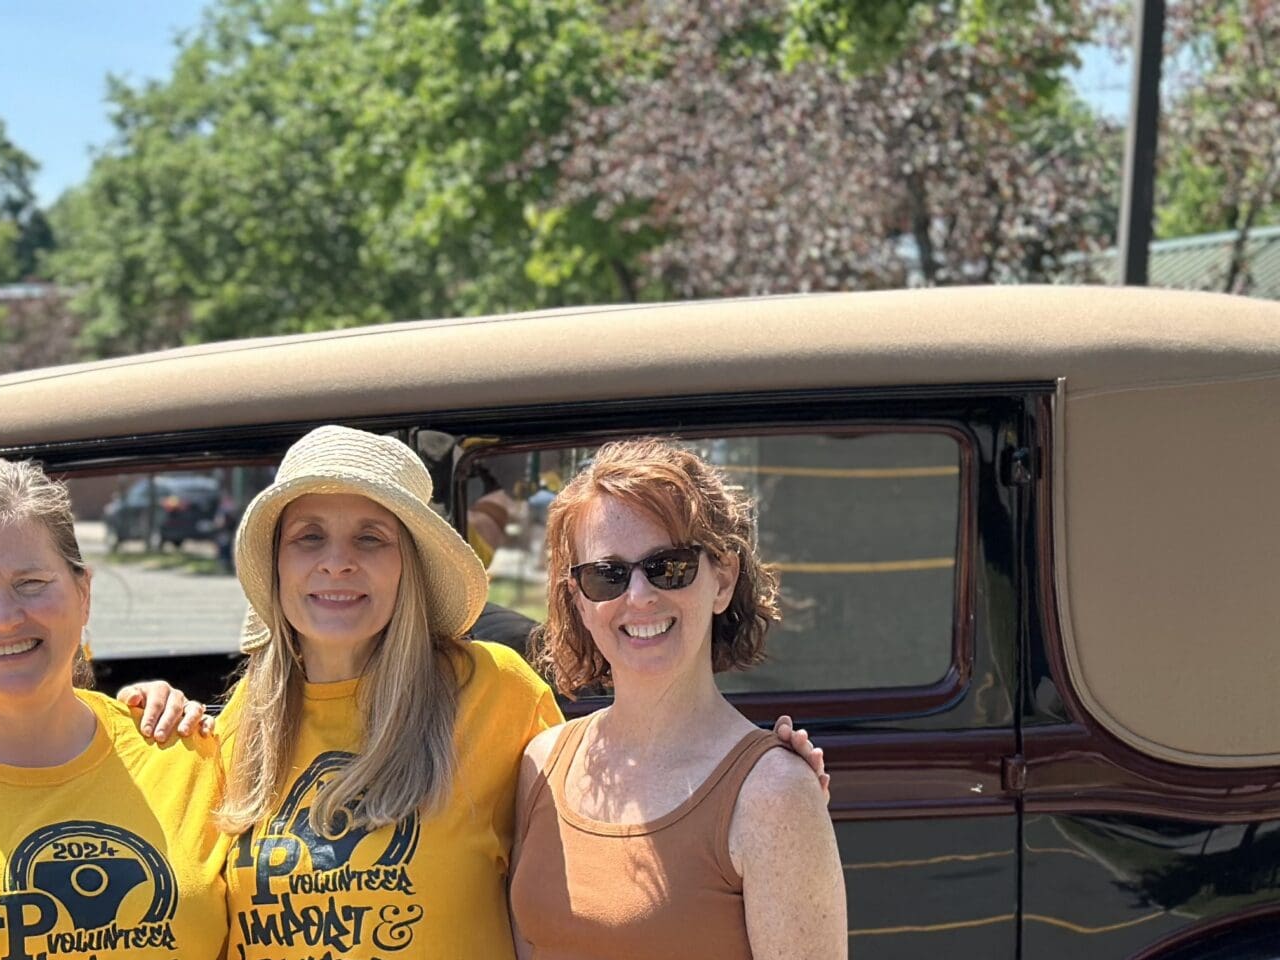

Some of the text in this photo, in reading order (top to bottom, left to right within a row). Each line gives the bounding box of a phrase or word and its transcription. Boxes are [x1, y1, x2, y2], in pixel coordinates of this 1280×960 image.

[52, 840, 119, 859] 2024
[289, 864, 416, 895] VOLUNTEER
[47, 921, 178, 954] VOLUNTEER
[238, 893, 424, 952] IMPORT &
